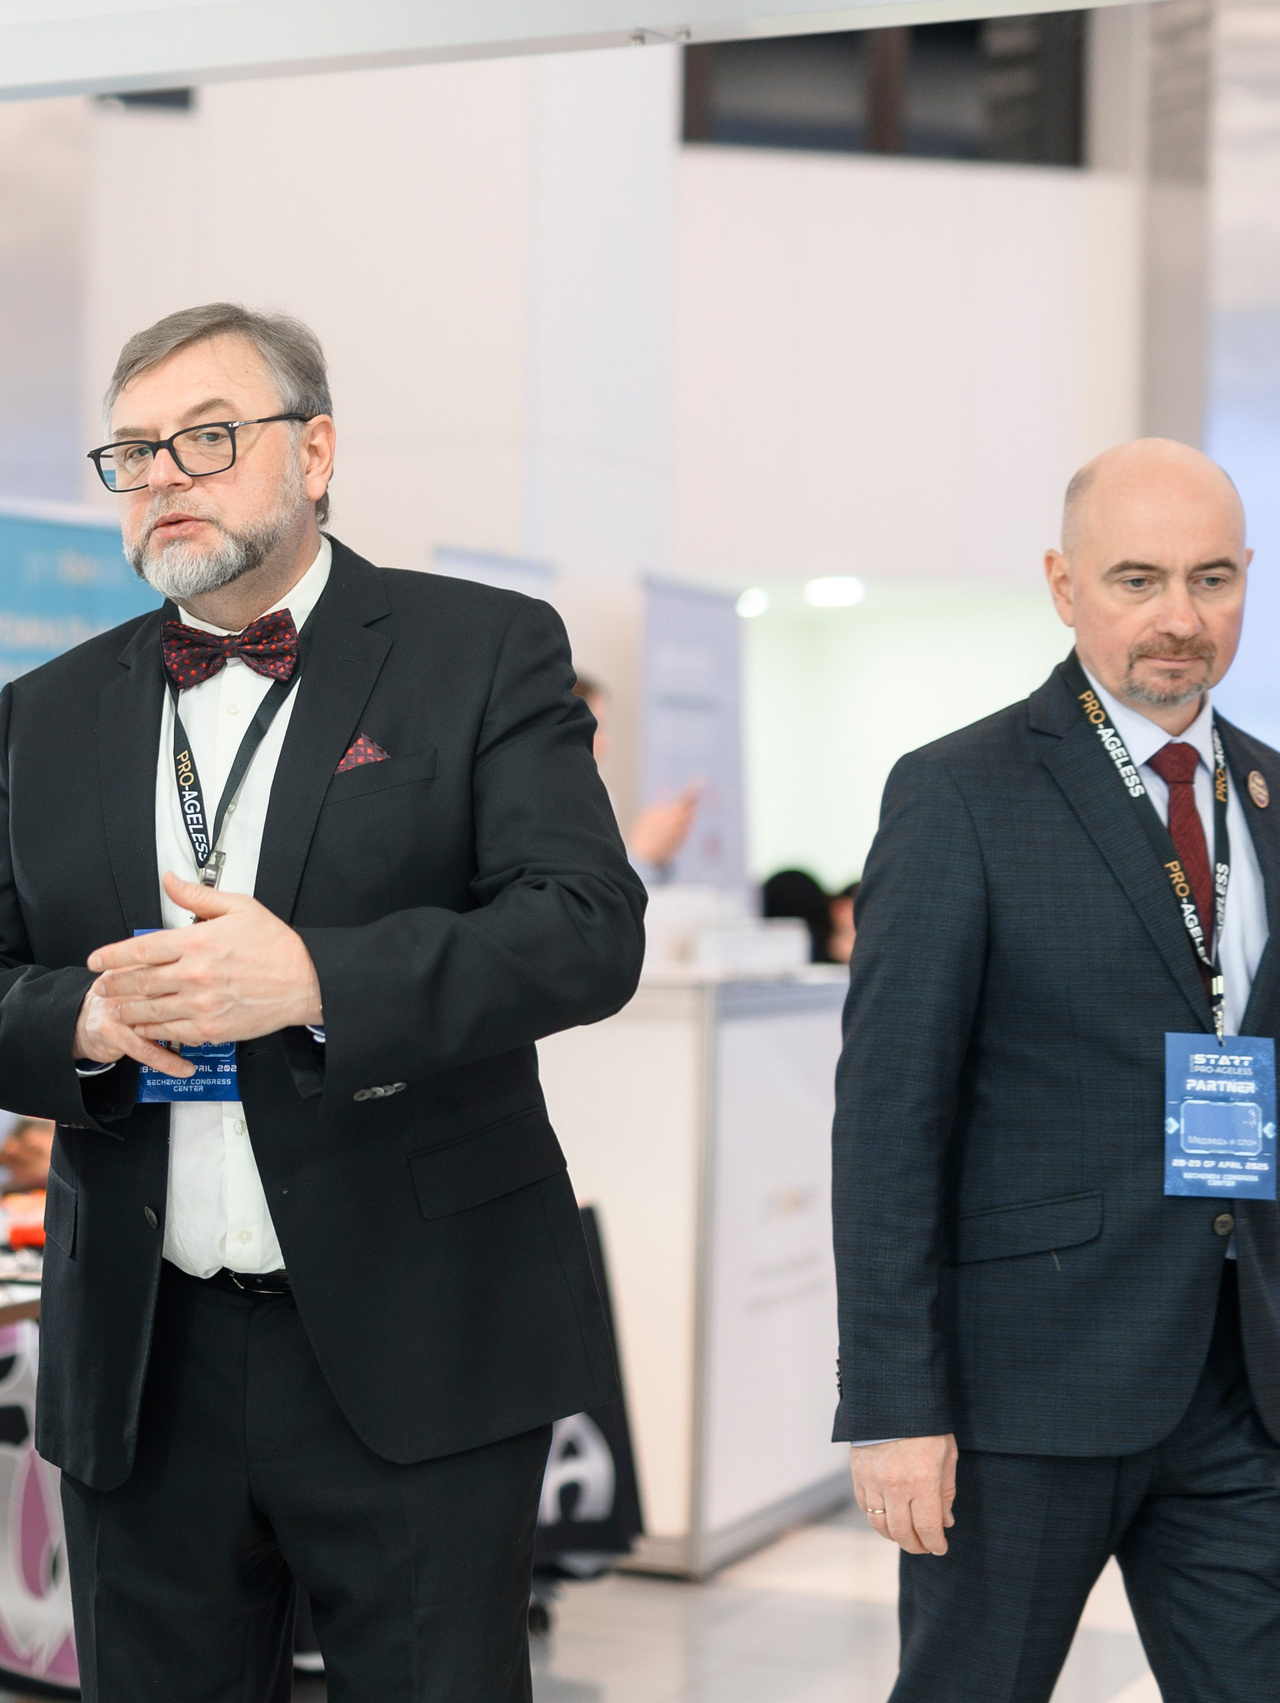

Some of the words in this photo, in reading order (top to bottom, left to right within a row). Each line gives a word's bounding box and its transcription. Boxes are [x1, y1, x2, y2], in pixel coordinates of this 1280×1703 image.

[1079, 690, 1145, 797] PRO-AGELESS
[1193, 1054, 1253, 1066] START
[1186, 1079, 1256, 1094] PARTNER
